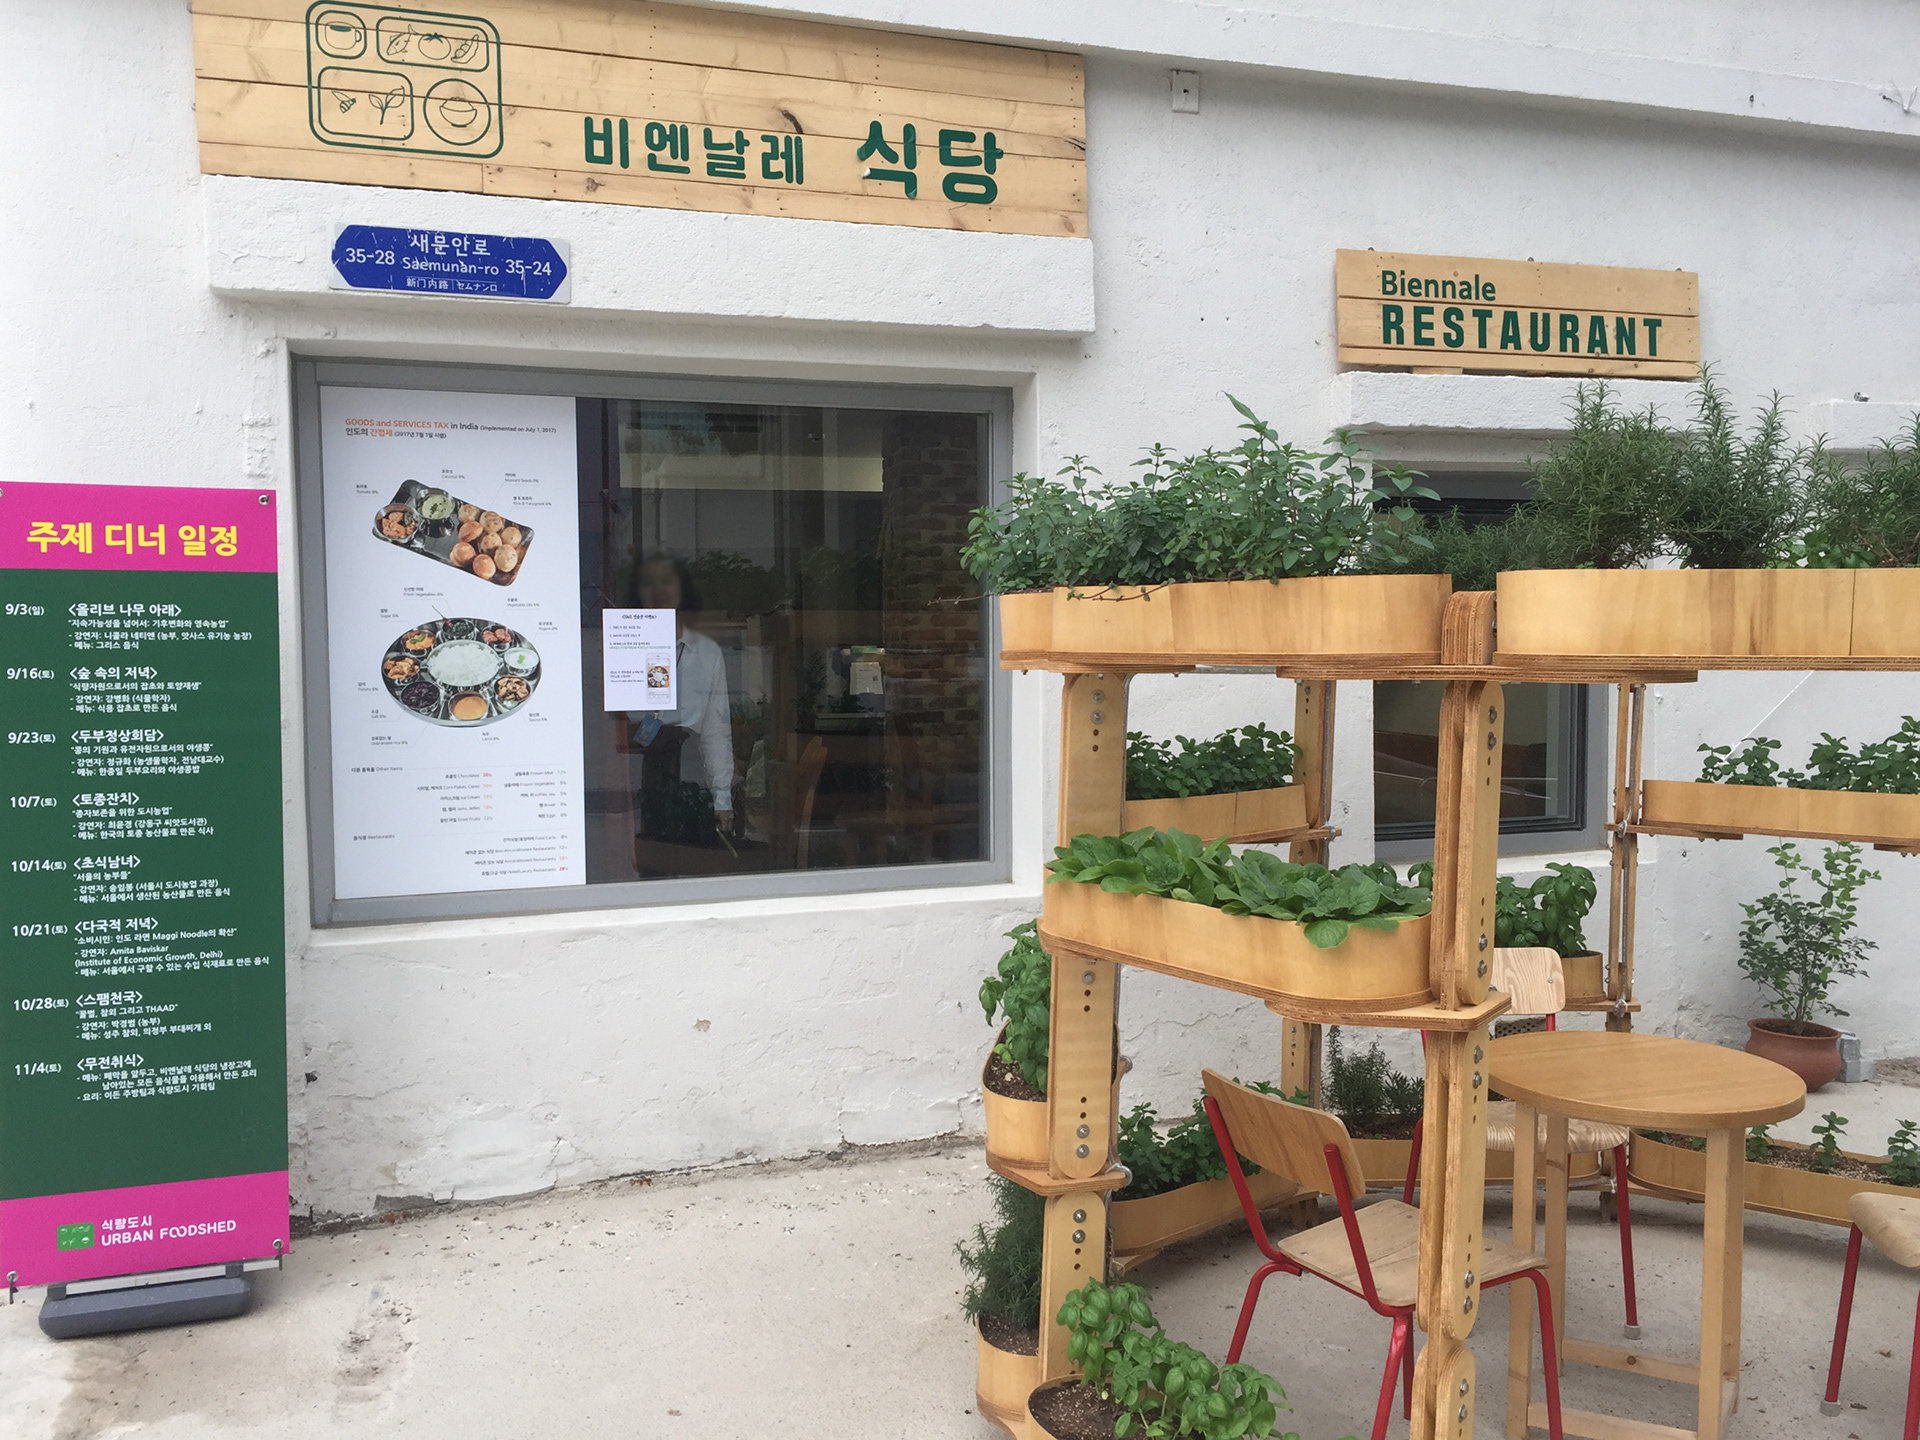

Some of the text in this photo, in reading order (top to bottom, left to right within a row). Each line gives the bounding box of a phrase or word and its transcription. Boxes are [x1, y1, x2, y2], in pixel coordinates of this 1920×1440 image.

[584, 116, 1004, 204] 비엔날레 식당
[410, 233, 491, 257] 새문안로
[345, 248, 395, 265] 35-28
[402, 257, 499, 276] Saemunan-ro
[505, 259, 552, 276] 35-24
[406, 277, 449, 290] 新门内路
[1381, 270, 1497, 301] Biennale
[1382, 304, 1662, 356] RESTAURANT
[345, 418, 479, 431] GOODS and SERVICES TAX in India
[28, 521, 237, 557] 주제 디너 일정
[5, 603, 45, 616] 9/3(일)
[68, 603, 182, 617] <올리브 나무 아래>
[152, 619, 192, 628] 기후변화와
[74, 631, 102, 641] 강연자:
[157, 631, 179, 641] (농부,
[206, 631, 231, 641] 유기농
[233, 631, 252, 641] 농장)
[74, 640, 139, 650] 메뉴: 그리스 음식
[6, 667, 55, 680] 9/16(토)
[69, 666, 158, 680] <숲 속의 저녁>
[140, 681, 165, 691] 잡초와
[75, 693, 171, 705] 강연자: (식물학자)
[75, 703, 177, 713] 메뉴: 식용 잡초로 만든 음식
[8, 731, 56, 744] 9/23(토)
[71, 728, 164, 743] <두부정상회담>
[93, 745, 118, 755] 기원과
[119, 743, 184, 754] 유전자원으로서의
[76, 757, 104, 767] 강연자:
[181, 755, 224, 765] 전남대교수)
[76, 767, 96, 777] 메뉴:
[125, 765, 166, 775] 두부요리와
[10, 795, 57, 808] 10/7(토)
[72, 791, 140, 807] <토종잔치>
[118, 807, 135, 817] 위한
[78, 821, 105, 831] 강연자:
[163, 817, 207, 827] 씨앗도서관)
[78, 826, 214, 840] 메뉴: 한국의 토종 농산물로 만든 식사
[11, 859, 67, 872] 10/14(토)
[73, 854, 141, 870] <초식남녀>
[79, 879, 219, 894] 강연자: (서울시 도시농업 과장)
[79, 893, 99, 904] 메뉴:
[100, 892, 134, 902] 서울에서
[162, 889, 194, 900] 농산물로
[196, 888, 213, 898] 만든
[214, 887, 230, 897] 음식
[12, 923, 68, 937] 10/21(토)
[74, 916, 158, 934] <다국적 저녁>
[115, 934, 132, 943] 인도
[152, 931, 178, 941] Maggi
[180, 928, 216, 939] Noodle의
[80, 944, 169, 958] 강연자: Amita Baviskar
[74, 950, 223, 968] (Institute of Economic Growth, Delhi)
[80, 967, 100, 977] 메뉴:
[102, 965, 135, 975] 서울에서
[155, 963, 164, 972] 수
[202, 958, 234, 969] 식재료로
[236, 957, 252, 967] 만든
[253, 956, 269, 966] 음식
[13, 997, 69, 1011] 10/28(토)
[75, 990, 143, 1007] <스팸천국>
[118, 1006, 144, 1015] 그리고
[81, 1017, 161, 1031] 강연자: (농부)
[81, 1031, 101, 1041] 메뉴:
[103, 1029, 120, 1040] 성주
[142, 1025, 167, 1036] 의정부
[203, 1022, 212, 1031] 외
[15, 1062, 62, 1076] 11/4(토)
[76, 1053, 144, 1071] <무전취식>
[82, 1073, 101, 1082] 메뉴:
[159, 1064, 192, 1076] 비엔날레
[193, 1062, 218, 1073] 식당의
[219, 1059, 251, 1071] 냉장고에
[102, 1079, 135, 1091] 남아있는
[189, 1071, 221, 1083] 이용해서
[223, 1070, 239, 1080] 만든
[241, 1068, 257, 1077] 요리
[82, 1092, 102, 1101] 요리:
[157, 1084, 189, 1095] 식량도시
[101, 1214, 152, 1231] 식량도시
[101, 1219, 236, 1246] URBAN FOODSHED
